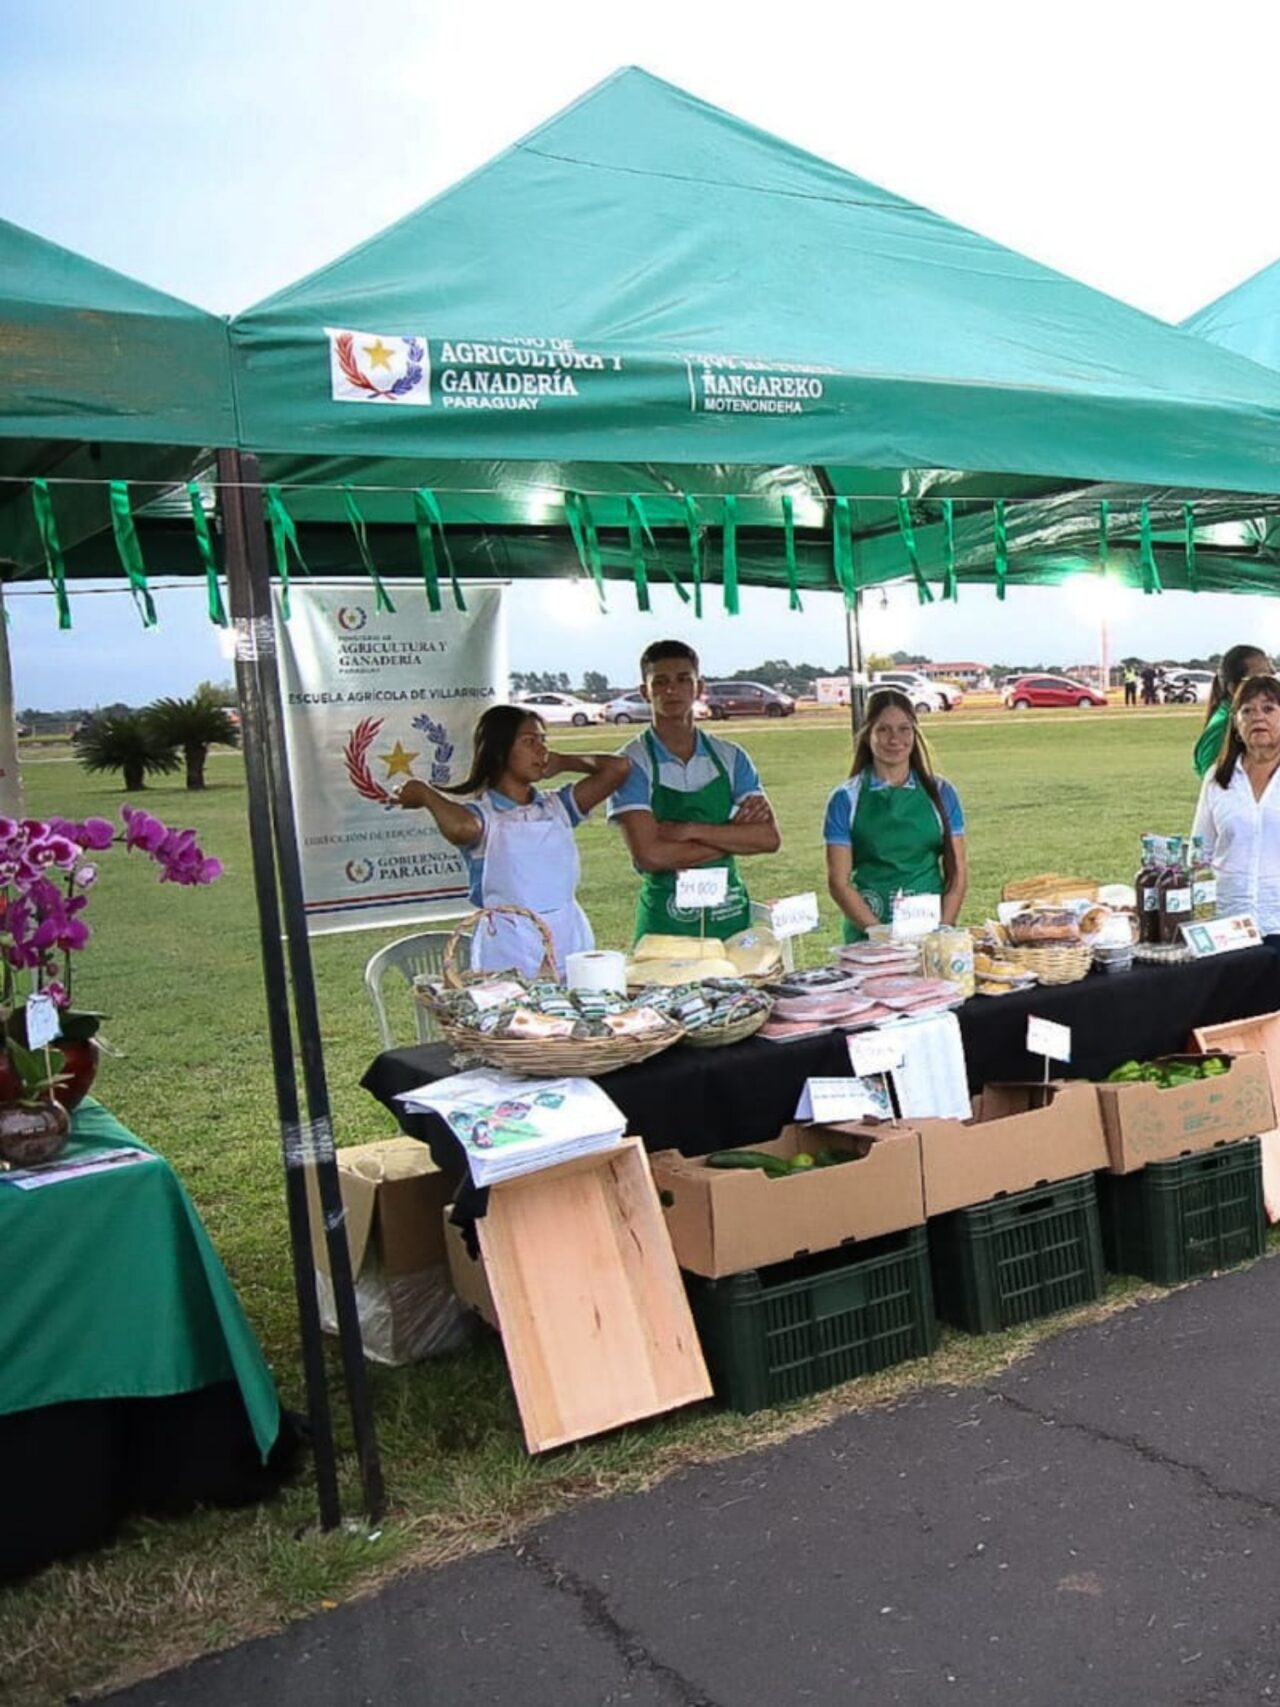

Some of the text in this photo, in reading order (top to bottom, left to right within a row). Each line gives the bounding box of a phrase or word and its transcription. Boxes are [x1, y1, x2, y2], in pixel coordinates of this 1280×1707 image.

[440, 369, 579, 396] GANADERÍA
[442, 397, 540, 410] PARAGUAY
[339, 641, 437, 653] AGRICULTURA
[339, 653, 422, 667] GANADERÍA
[288, 686, 495, 705] ESCUELA AGRÍCOLA DE VILLARRICA
[378, 852, 448, 867] GOBIERNO
[380, 861, 463, 880] PARAGUAY
